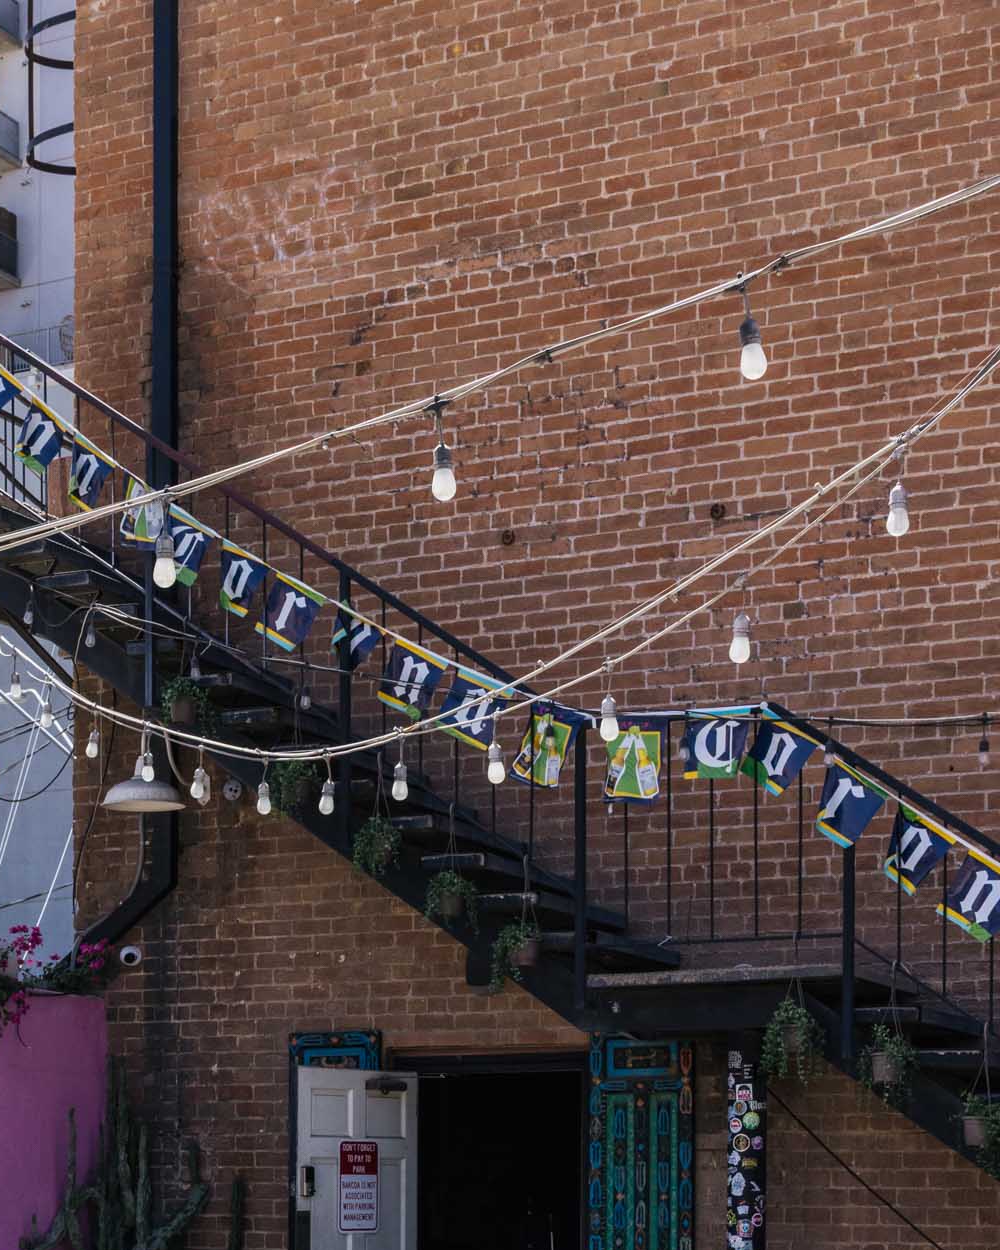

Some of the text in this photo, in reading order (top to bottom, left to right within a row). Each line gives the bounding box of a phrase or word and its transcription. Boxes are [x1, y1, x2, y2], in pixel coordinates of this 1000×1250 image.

[343, 1143, 376, 1152] DON'T FORGET
[347, 1153, 371, 1163] TO PAY TO
[353, 1165, 365, 1174] PARK
[345, 1192, 372, 1200] ASSOCIATED
[343, 1203, 375, 1211] WITH PARKING
[343, 1213, 374, 1221] MANAGEMENT
